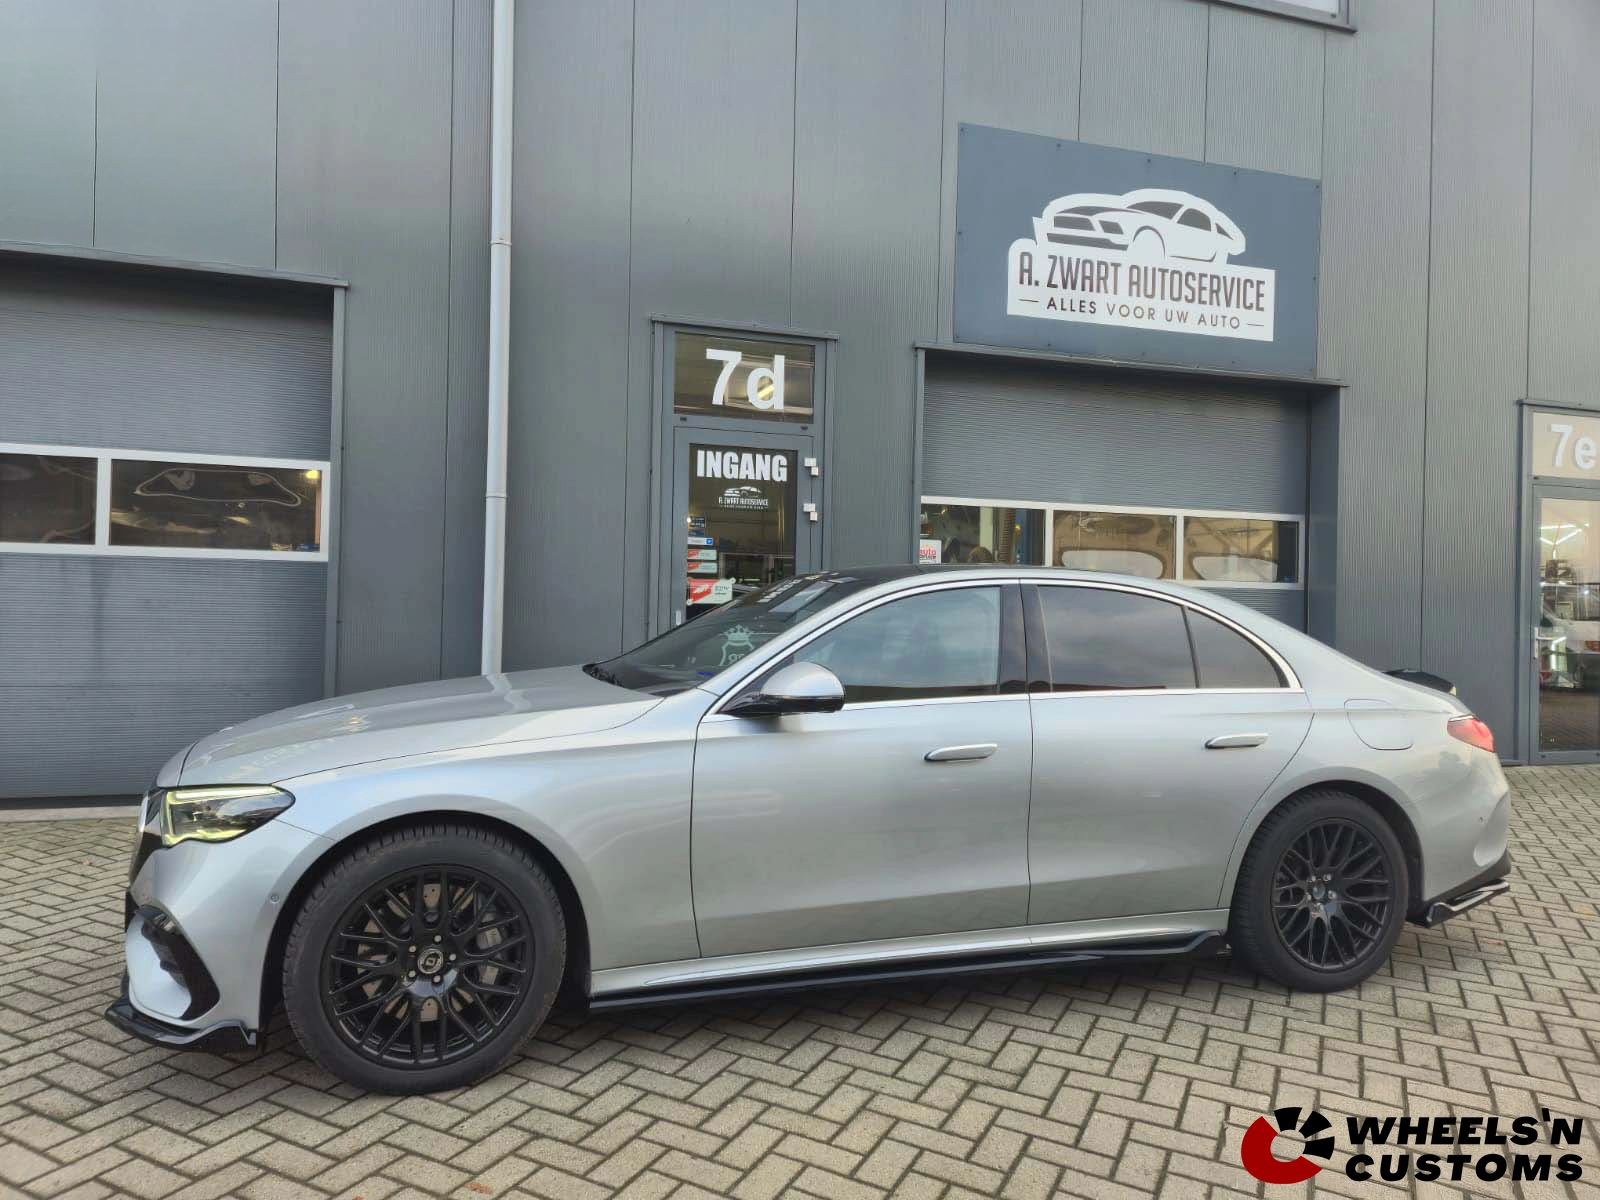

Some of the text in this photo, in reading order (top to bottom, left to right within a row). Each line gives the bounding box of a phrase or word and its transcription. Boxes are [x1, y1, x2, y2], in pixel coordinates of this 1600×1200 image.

[1018, 251, 1265, 312] A. ZWART AUTOSERVICE
[1047, 297, 1240, 330] ALLES VOOR UW AUTO
[706, 349, 785, 410] 7d
[696, 450, 788, 482] INGANG
[1551, 424, 1597, 470] 7e
